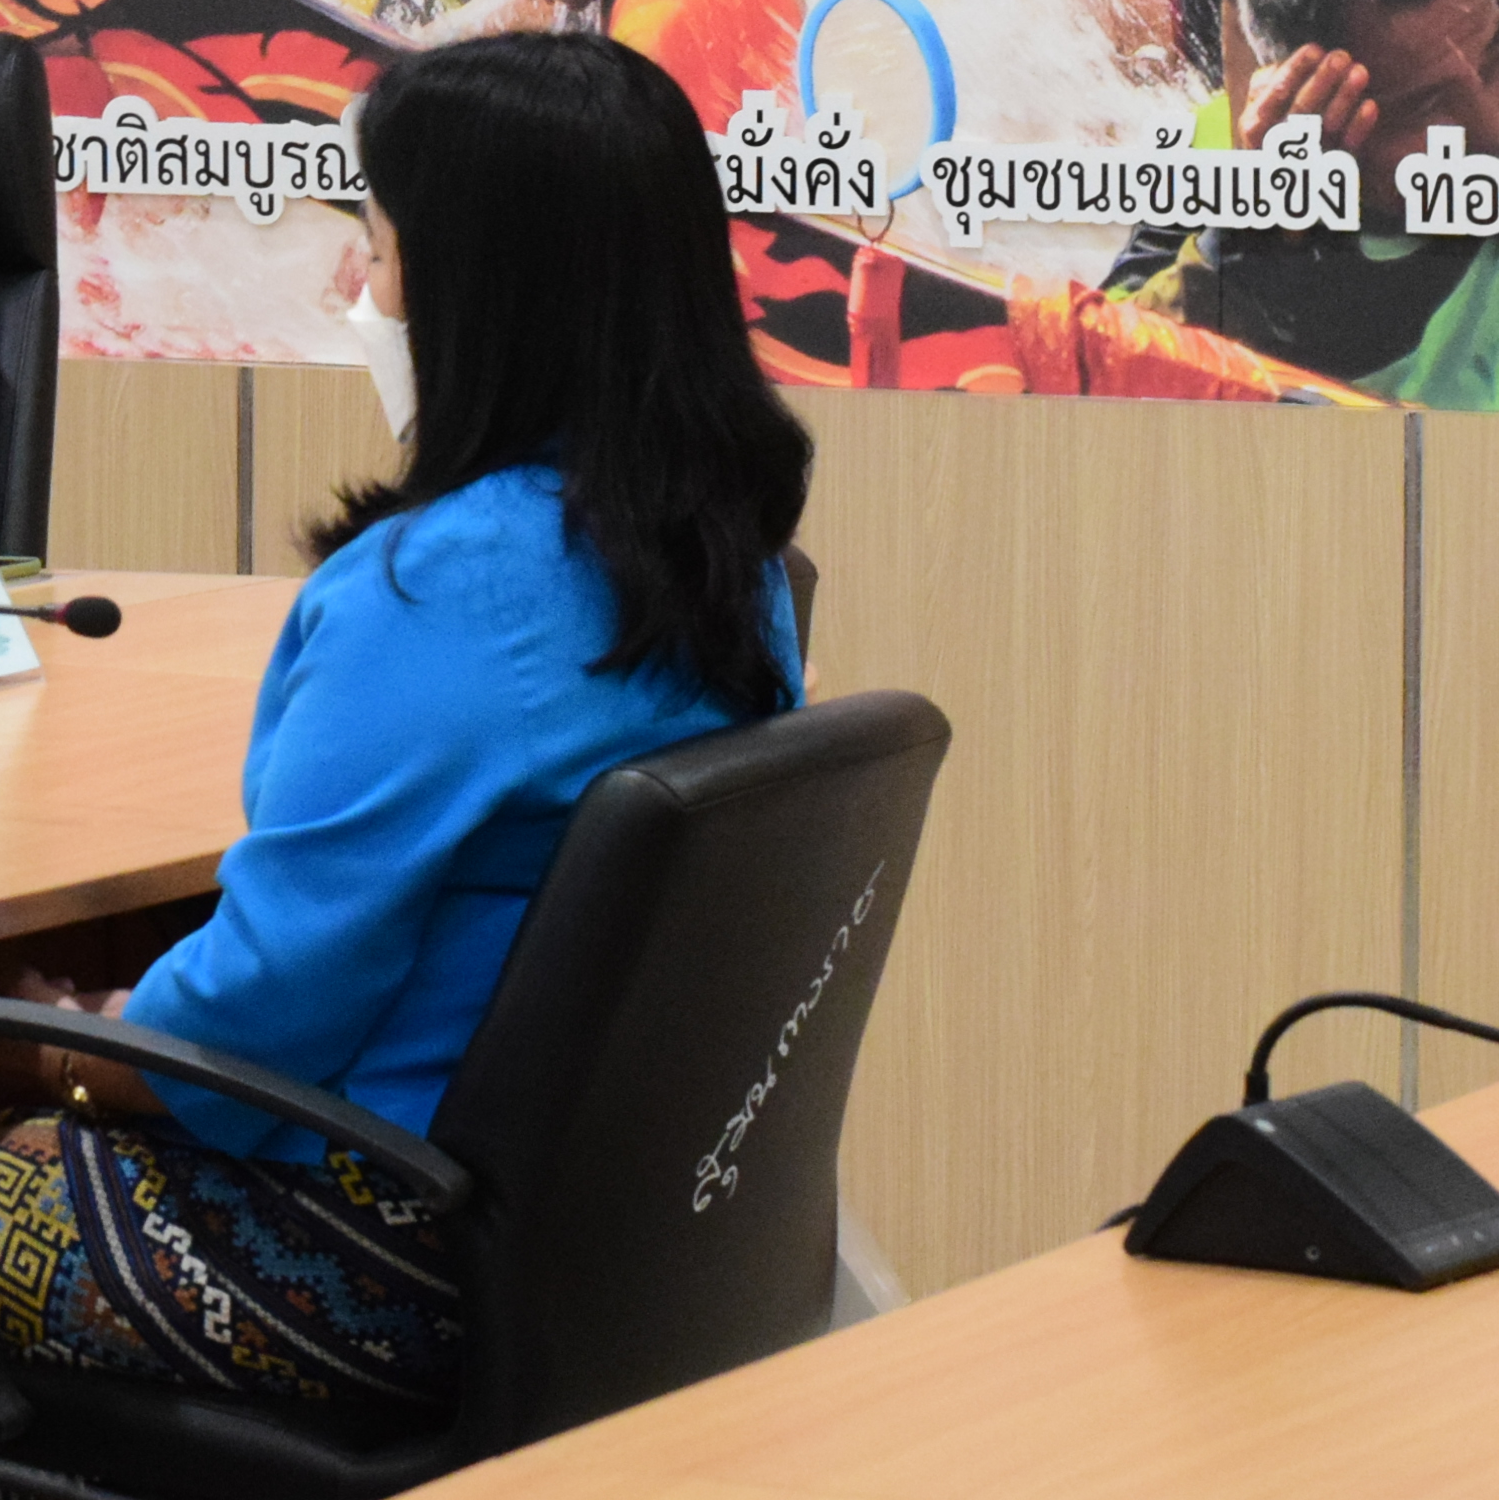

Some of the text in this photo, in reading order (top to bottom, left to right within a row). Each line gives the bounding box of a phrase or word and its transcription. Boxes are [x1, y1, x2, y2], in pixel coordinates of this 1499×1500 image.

[726, 109, 875, 208] มั่งคั่ง
[932, 127, 1348, 237] ชุมชนเข้มแข็ง
